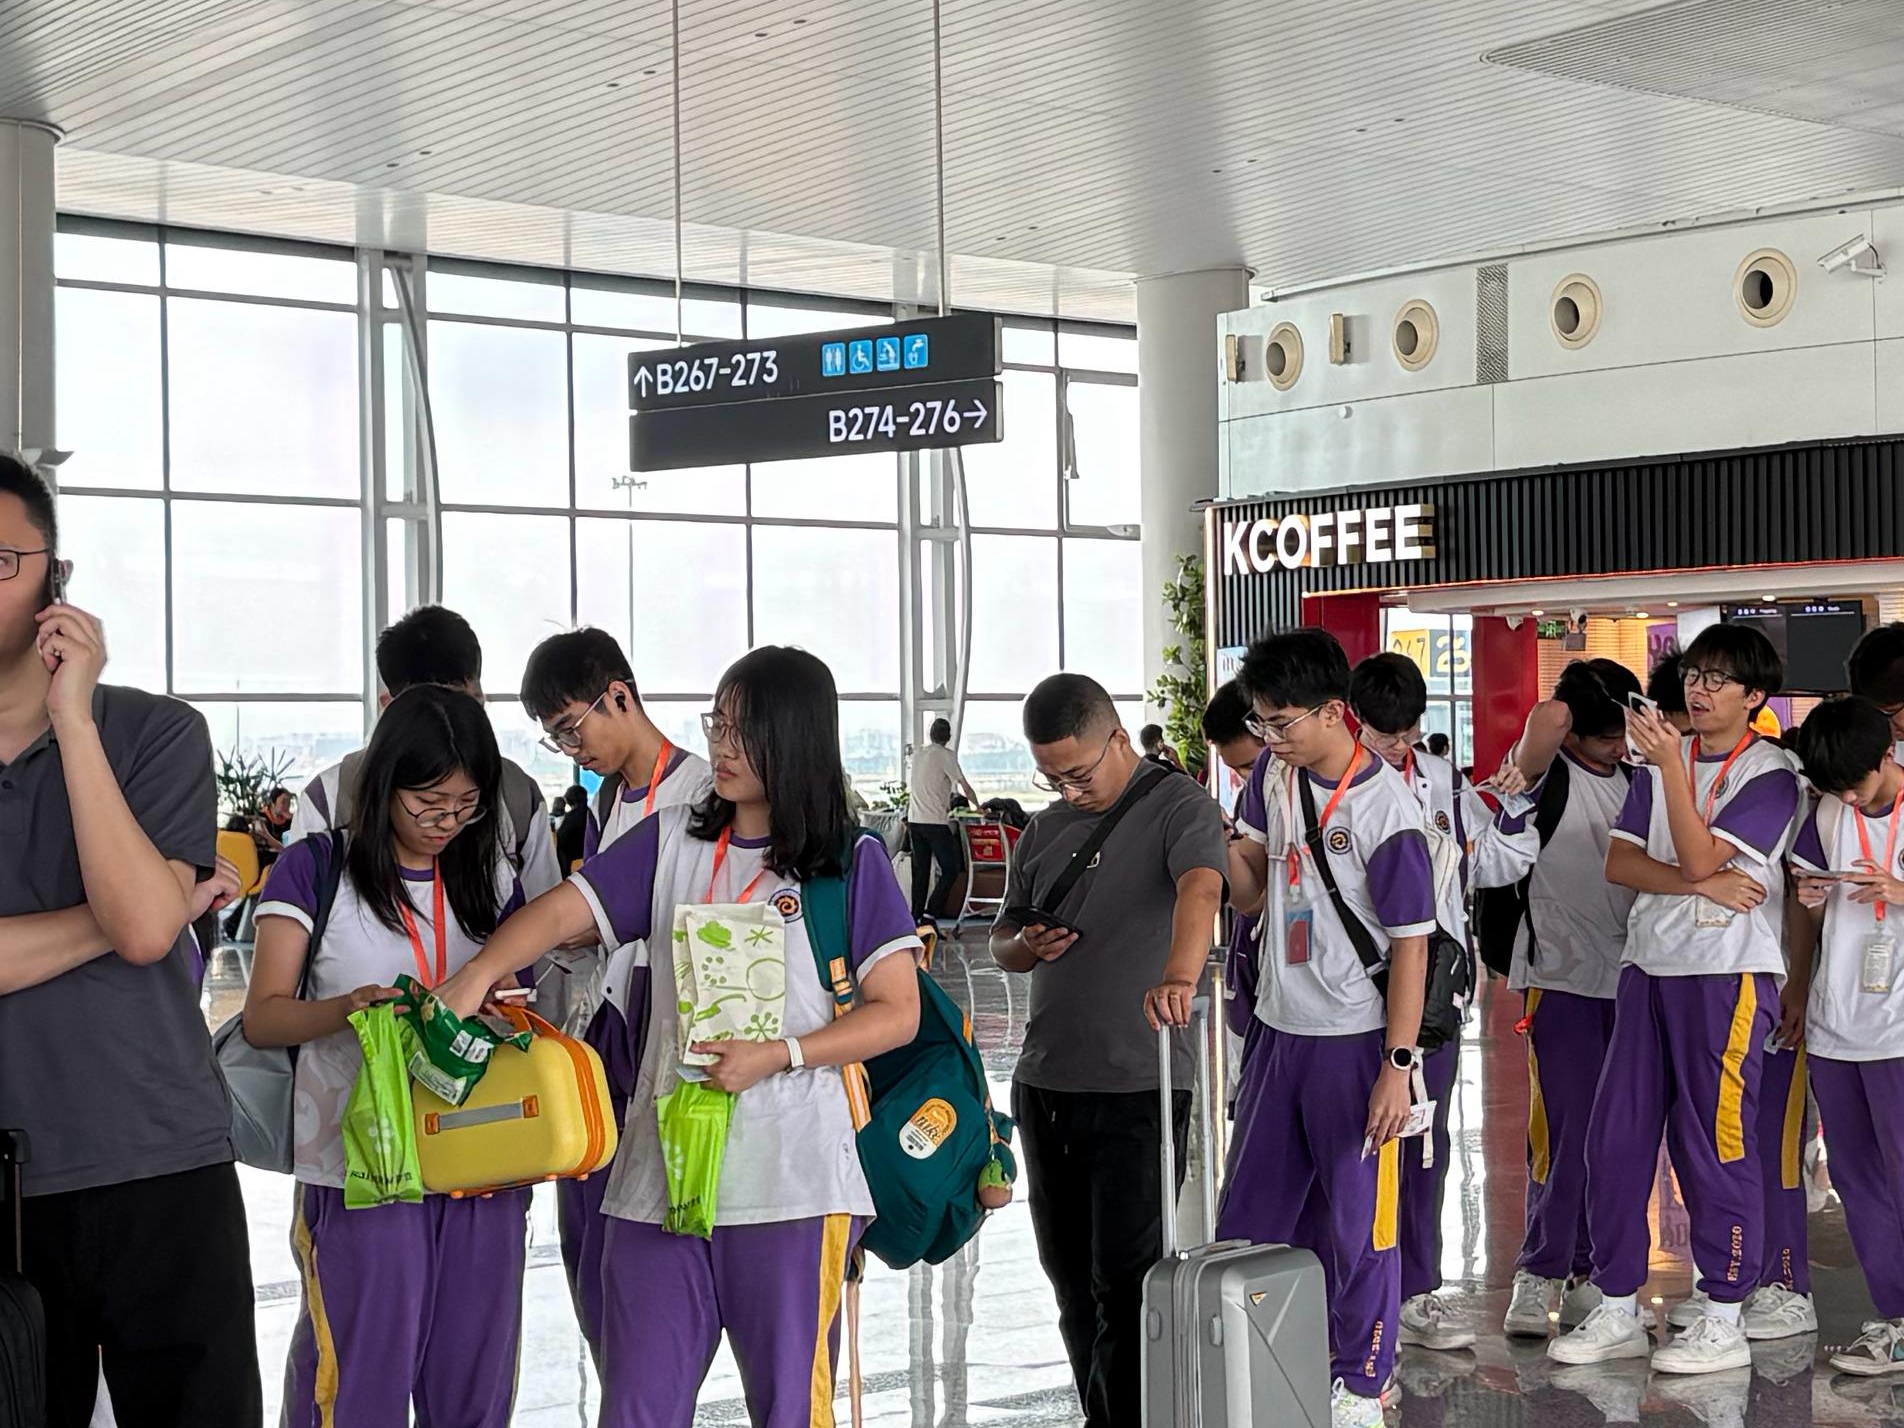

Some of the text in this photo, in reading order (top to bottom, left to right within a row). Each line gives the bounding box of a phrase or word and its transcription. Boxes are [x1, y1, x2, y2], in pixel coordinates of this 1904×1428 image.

[657, 350, 779, 395] B267-273
[829, 400, 962, 444] B274-276
[1223, 503, 1428, 575] KCOFFEE
